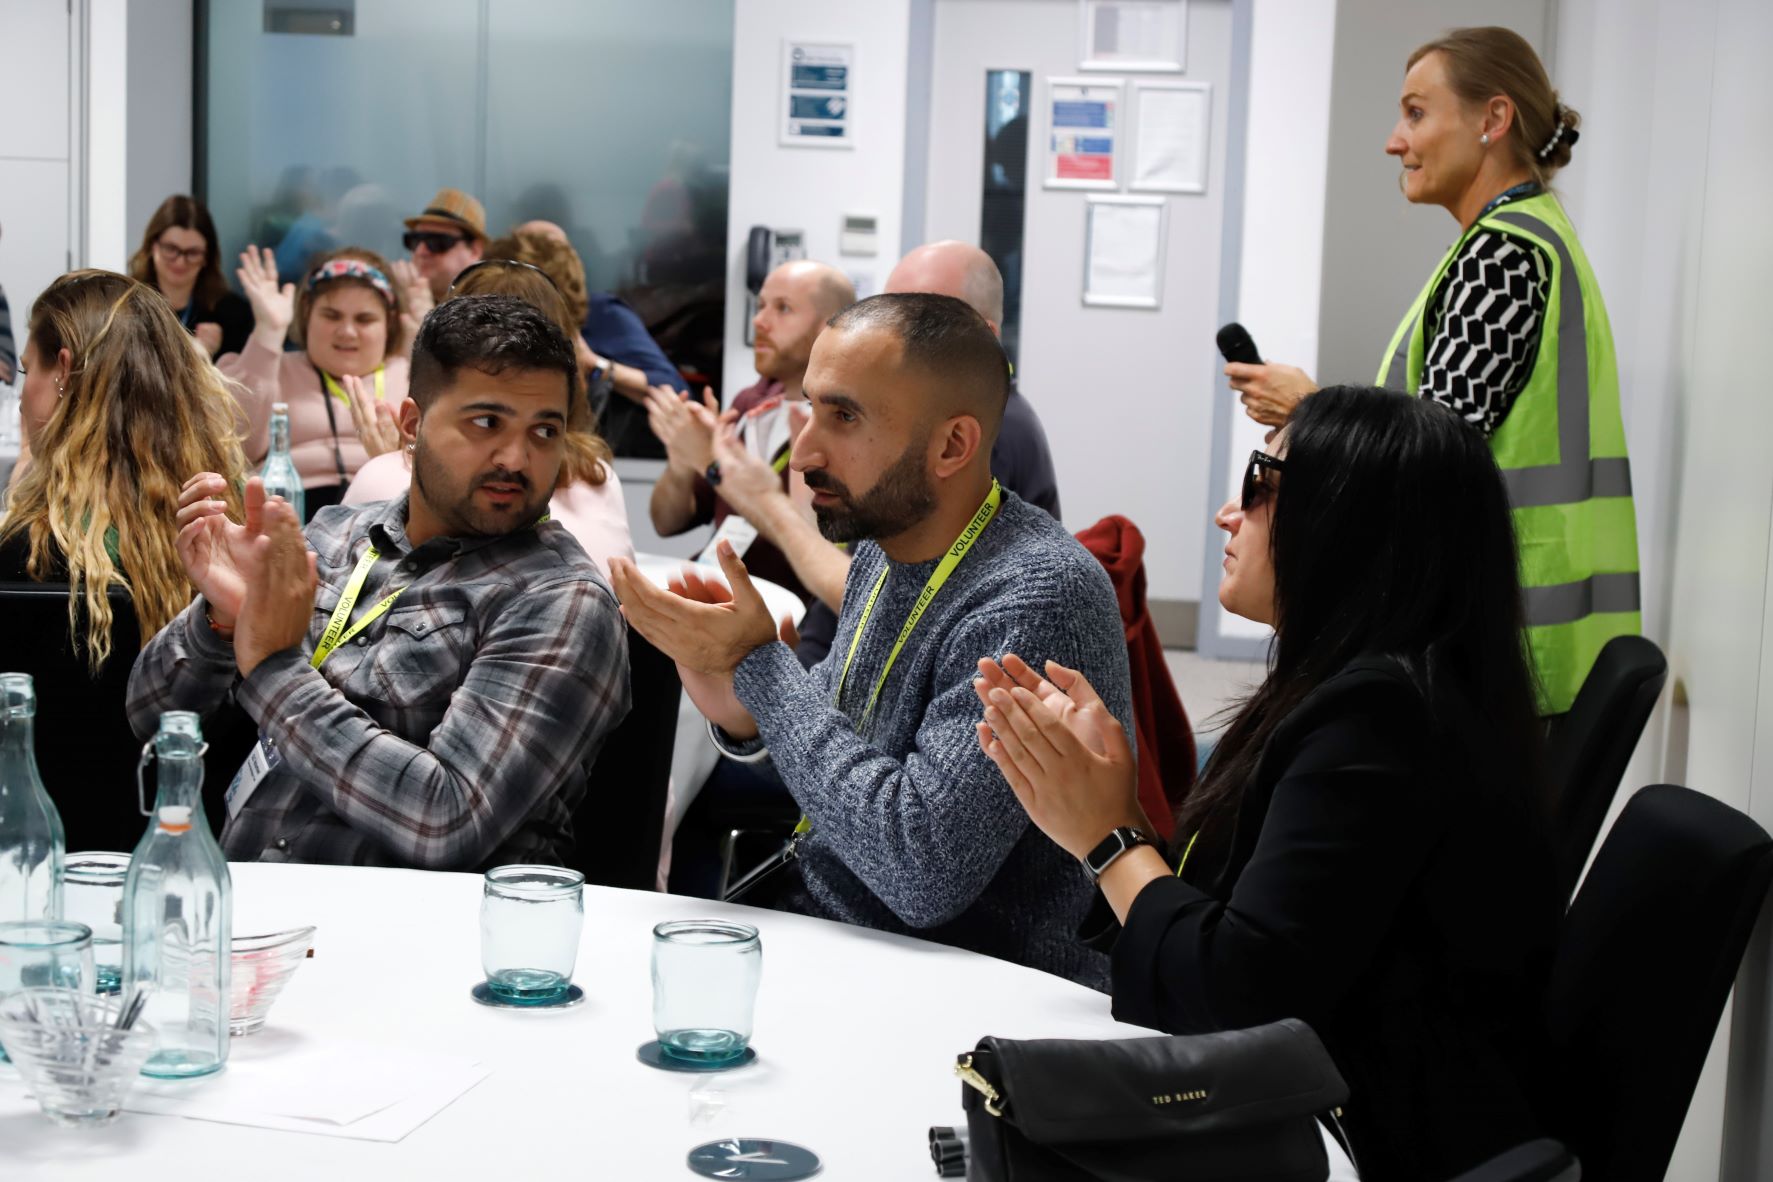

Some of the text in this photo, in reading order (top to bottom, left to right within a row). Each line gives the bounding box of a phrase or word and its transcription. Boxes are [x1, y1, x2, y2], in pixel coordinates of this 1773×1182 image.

[950, 502, 994, 557] VOLUNTEER
[321, 597, 353, 650] VOLUNTEER
[898, 585, 935, 643] VOLUNTEER
[1152, 1090, 1206, 1104] TED BAKER
